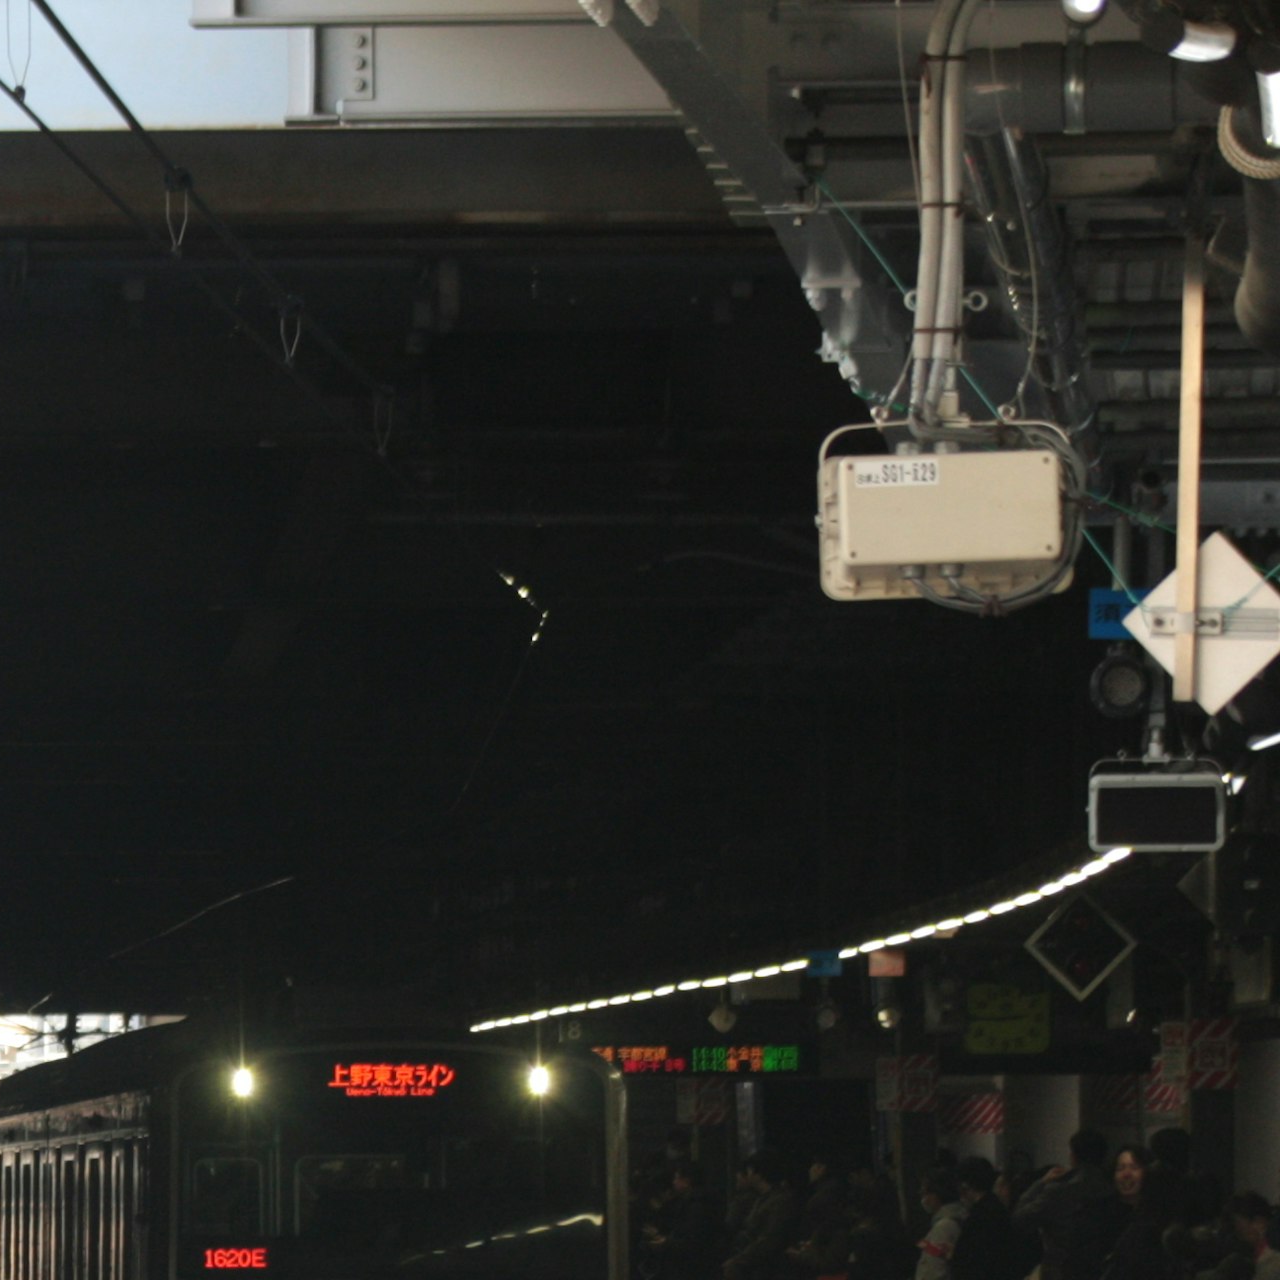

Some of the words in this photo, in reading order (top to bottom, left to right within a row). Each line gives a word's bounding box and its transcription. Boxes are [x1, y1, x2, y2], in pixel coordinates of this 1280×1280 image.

[327, 1062, 456, 1087] 上野東京ライン
[204, 1247, 268, 1269] 1620E
